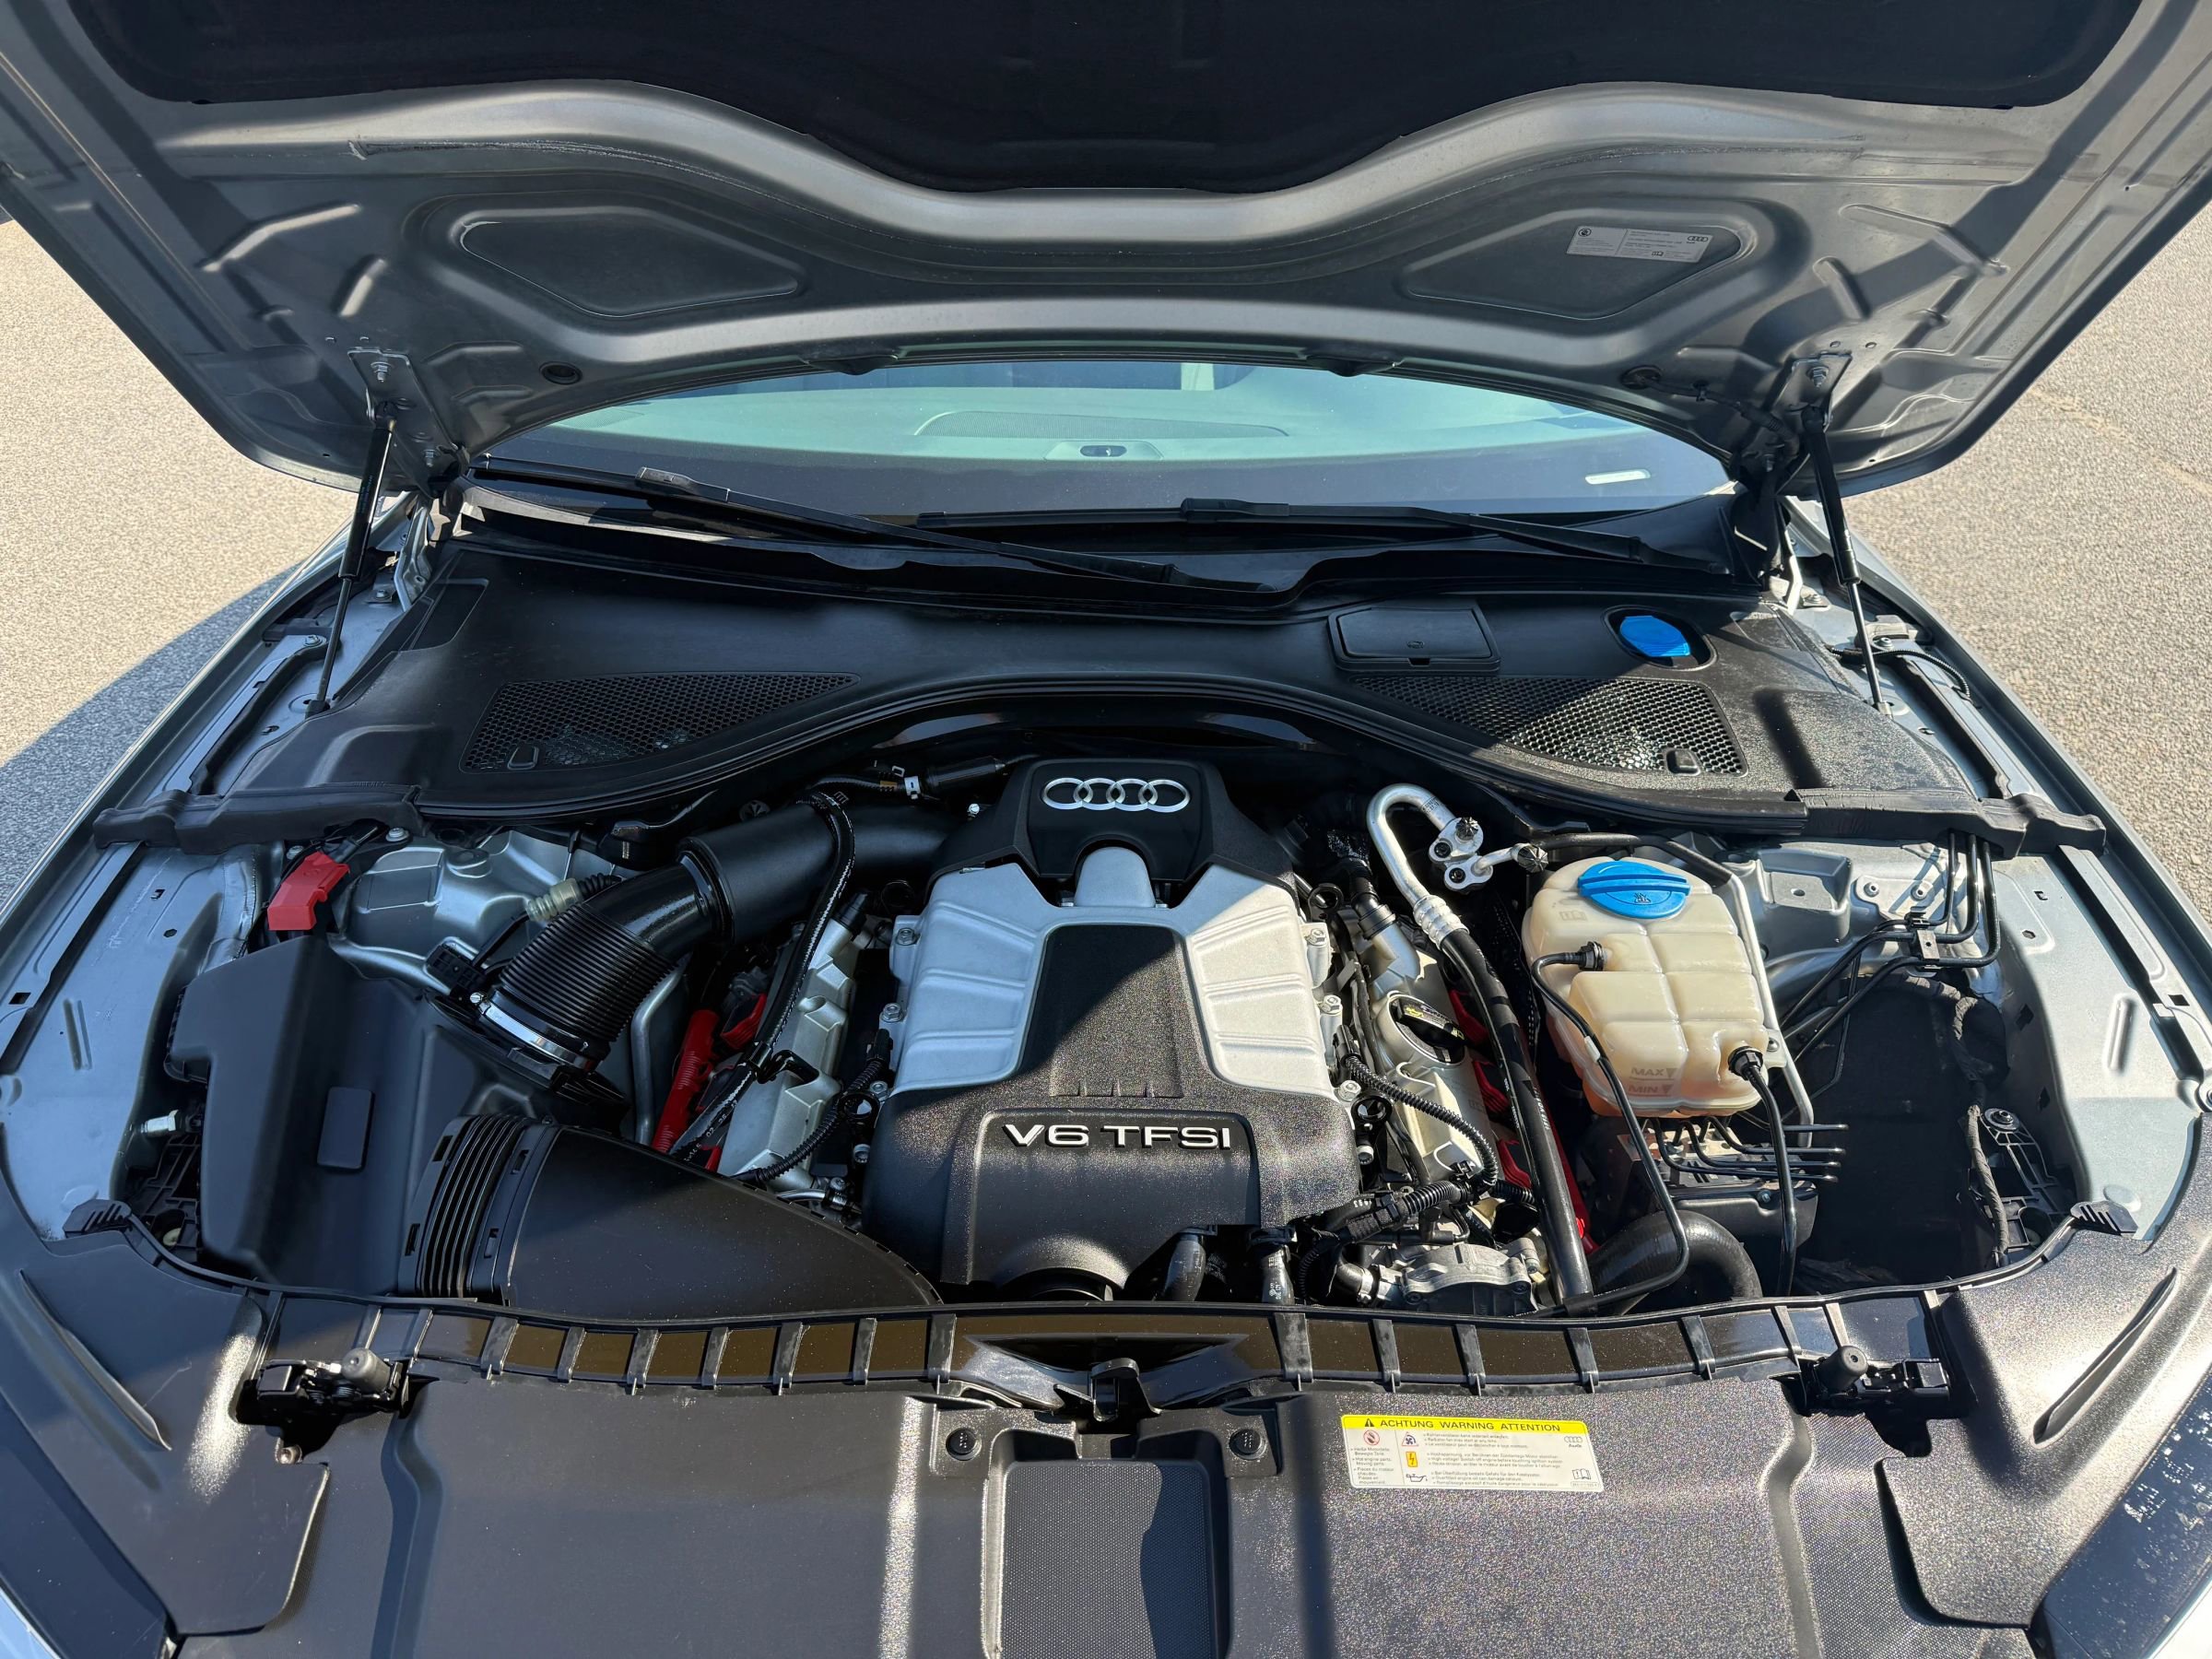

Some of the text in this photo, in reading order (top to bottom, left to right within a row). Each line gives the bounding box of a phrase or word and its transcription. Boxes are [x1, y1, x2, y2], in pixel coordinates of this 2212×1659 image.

[1630, 1066, 1665, 1077] MAX
[1628, 1084, 1659, 1094] MIN
[1003, 1124, 1231, 1150] V6 TFSI
[1380, 1419, 1560, 1432] ACHTUNG WARNING ATTENTION
